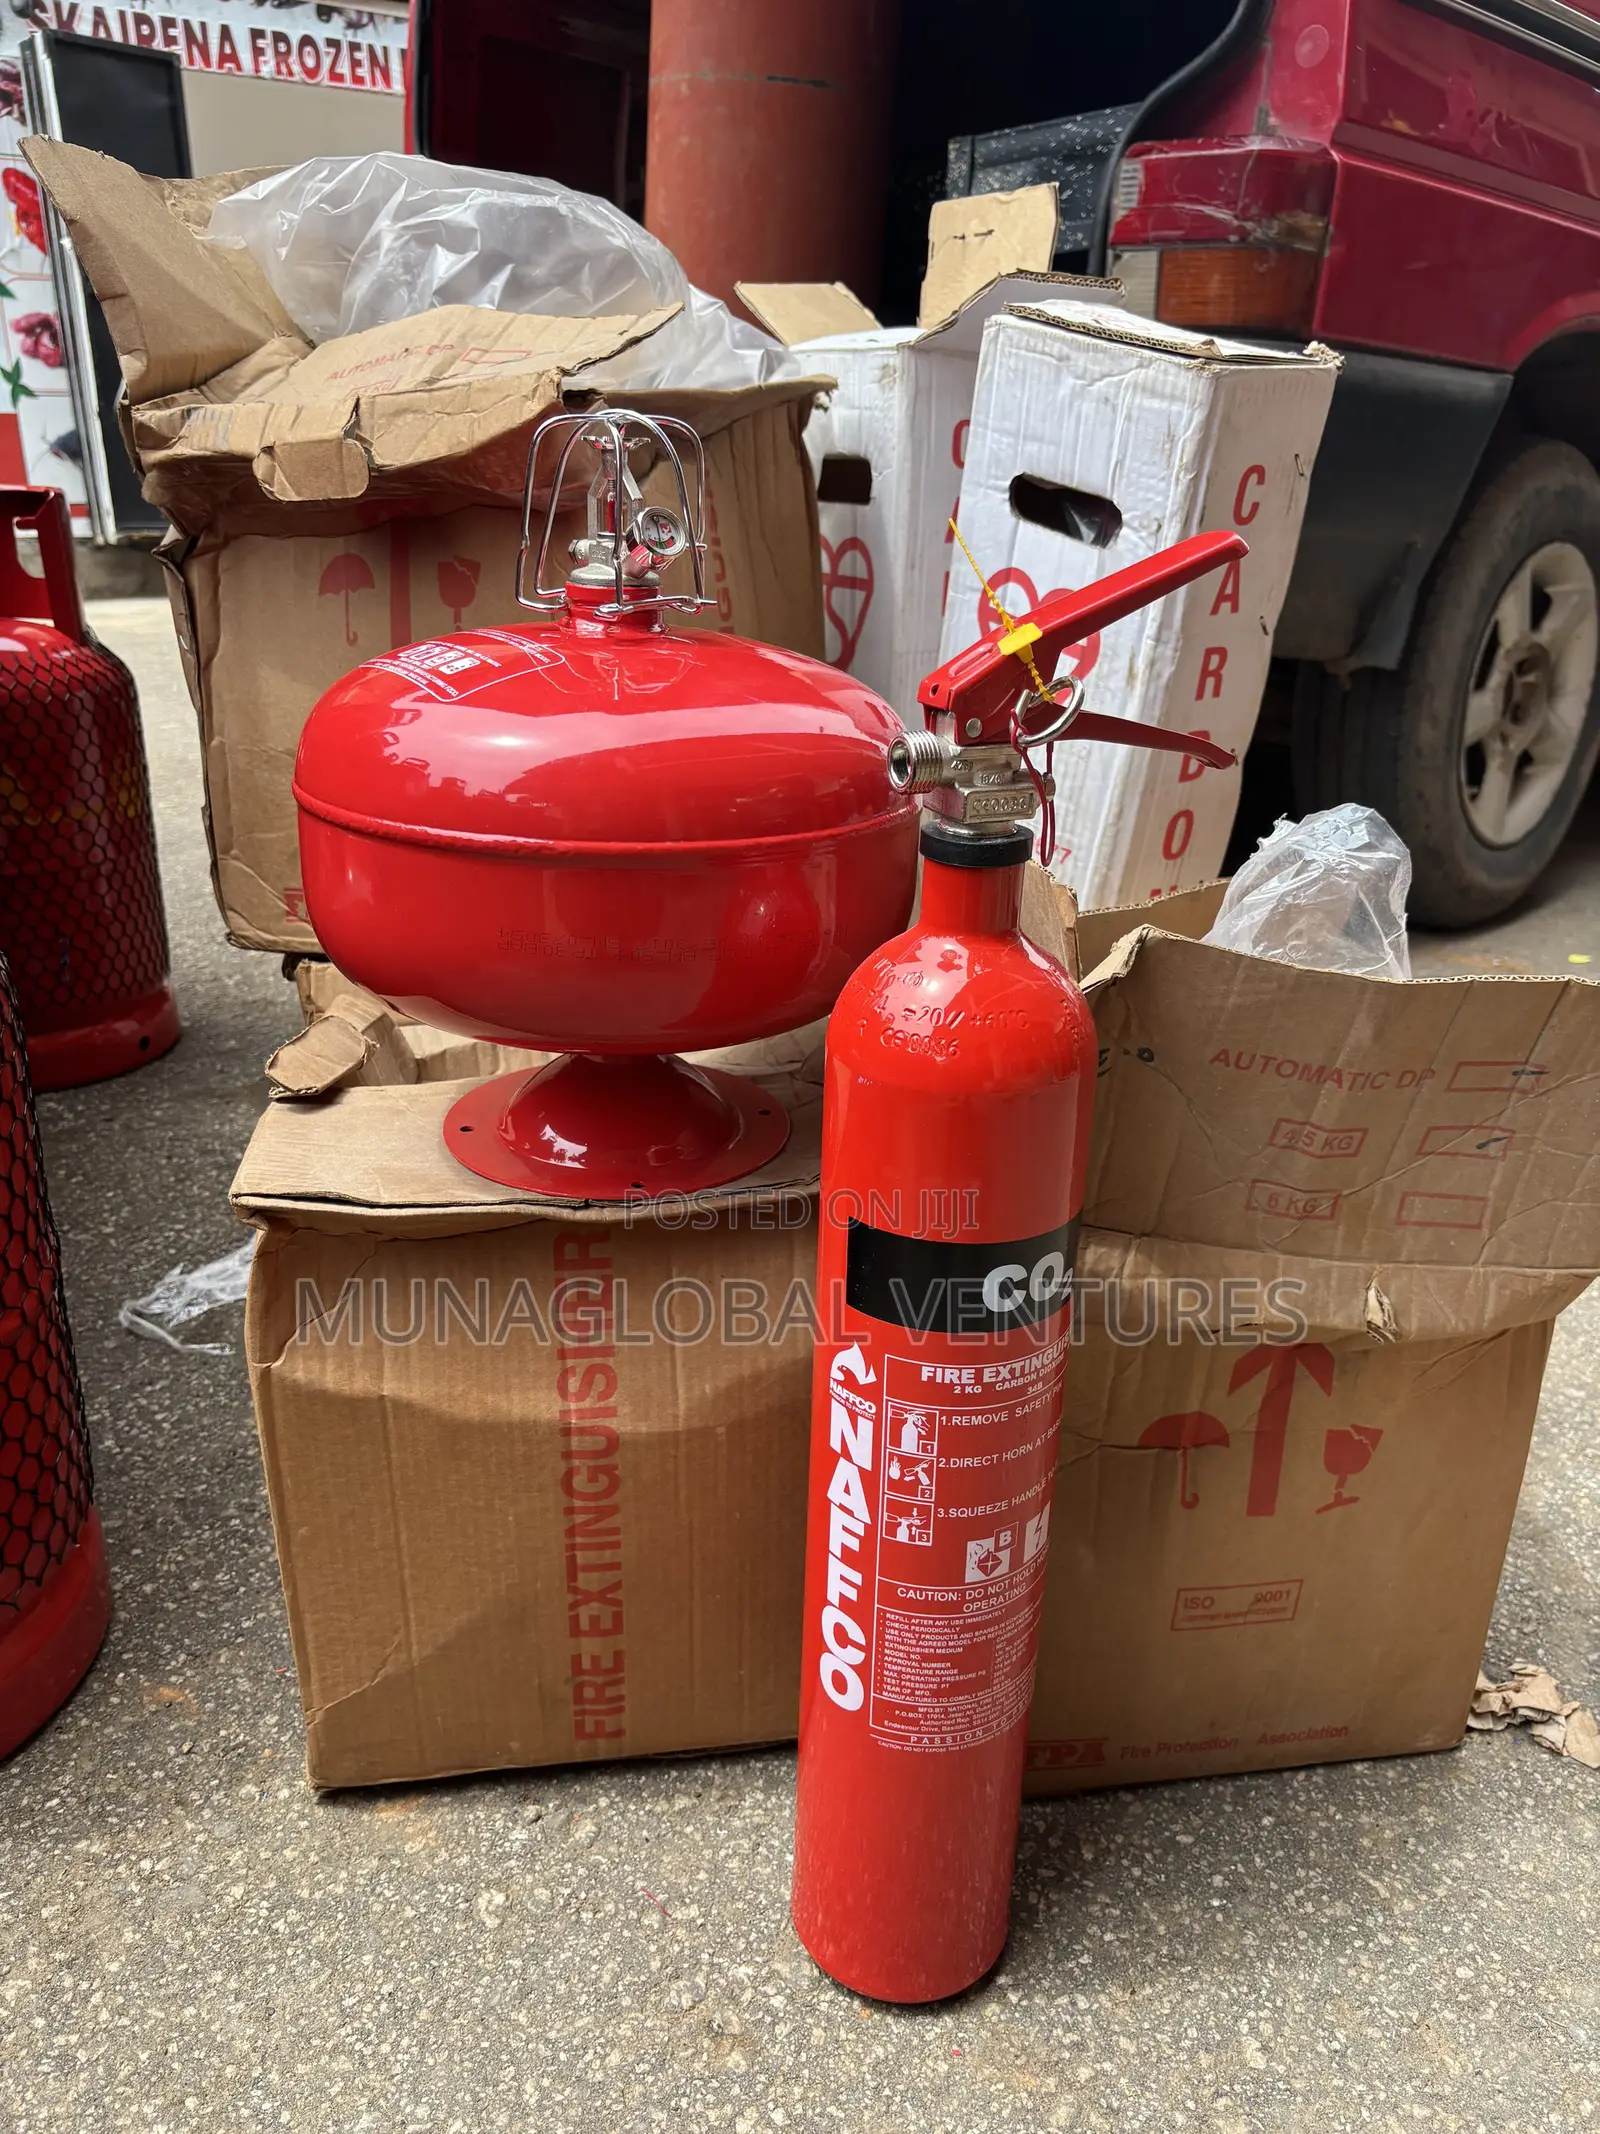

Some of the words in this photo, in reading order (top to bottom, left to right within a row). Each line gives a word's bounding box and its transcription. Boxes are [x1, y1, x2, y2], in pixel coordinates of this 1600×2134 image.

[247, 28, 393, 91] FROZEN
[1150, 464, 1266, 897] CARBO
[1210, 1047, 1390, 1092] AUTOMATIC
[1395, 1068, 1436, 1090] DP
[1320, 1134, 1355, 1152] KG
[1267, 1192, 1280, 1208] 6
[1285, 1195, 1318, 1213] KG
[920, 1366, 976, 1384] FIRE
[982, 1332, 1071, 1385] EXTINGUIS
[953, 1386, 962, 1394] 2
[964, 1385, 982, 1394] KG
[995, 1371, 1038, 1392] CARBON
[1027, 1381, 1043, 1395] 34B
[830, 1379, 876, 1414] NAFFCO
[940, 1411, 1009, 1427] 1.REMOVE
[1015, 1390, 1052, 1417] SAFETY
[553, 1229, 626, 1639] EXTINGUISHER
[938, 1454, 1000, 1469] 2.DIRECT
[1002, 1441, 1033, 1462] HORN
[1034, 1432, 1047, 1449] AT
[937, 1499, 1009, 1518] 3.SQUEEZE
[1011, 1477, 1047, 1507] HANDLE
[999, 1529, 1012, 1547] B
[819, 1397, 873, 1712] NAFFCO
[897, 1587, 962, 1601] CAUTION:
[965, 1589, 984, 1600] DO
[988, 1582, 1010, 1597] NOT
[1012, 1567, 1036, 1584] HOLD
[963, 1582, 1028, 1613] OPERATING
[1183, 1596, 1216, 1610] ISO
[886, 1612, 909, 1622] REFILL
[966, 1608, 1006, 1624] IMMEDIATELY
[886, 1621, 909, 1630] CHECK
[975, 1624, 998, 1637] SPARES
[885, 1634, 902, 1642] WITH
[948, 1637, 971, 1646] MODEL
[973, 1635, 986, 1643] FOR
[885, 1641, 934, 1653] EXTINGUISHER
[884, 1648, 908, 1659] MODEL
[884, 1655, 919, 1667] APPROVAL
[883, 1670, 899, 1678] MAX.
[901, 1673, 940, 1682] OPERATING
[942, 1673, 976, 1682] PRESSURE
[884, 1663, 934, 1675] TEMPERATURE
[883, 1677, 899, 1685] TEST
[901, 1681, 937, 1689] PRESSURE
[883, 1684, 900, 1692] YEAR
[572, 1649, 627, 1742] FIRE
[882, 1691, 937, 1703] MANUFACTURED
[949, 1693, 976, 1702] COMPLY
[977, 1688, 992, 1696] WITH
[895, 1710, 925, 1718] P.O.BOX:
[948, 1702, 978, 1712] NATIONAL
[884, 1720, 920, 1731] Endeavour
[910, 1730, 983, 1744] PASSION
[992, 1717, 1007, 1730] TO
[1120, 1745, 1152, 1760] Fire
[1156, 1735, 1240, 1757] Protection
[1256, 1724, 1349, 1746] Association
